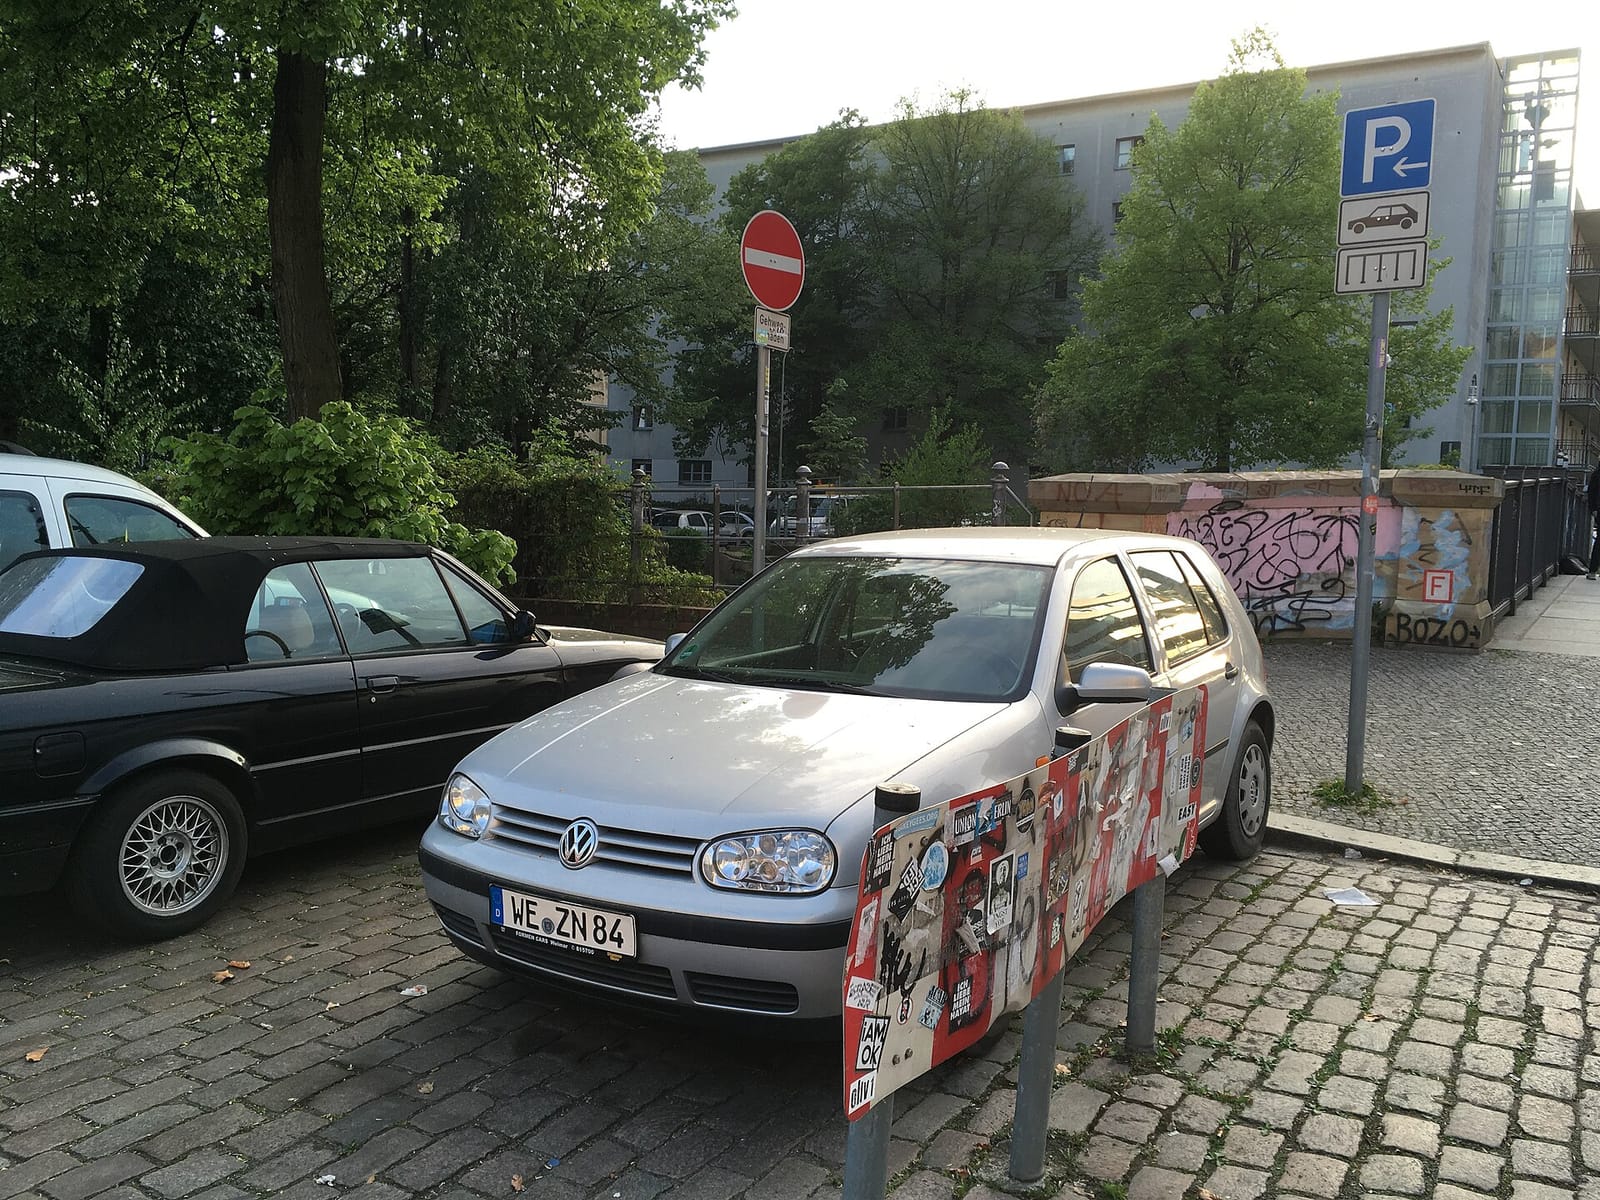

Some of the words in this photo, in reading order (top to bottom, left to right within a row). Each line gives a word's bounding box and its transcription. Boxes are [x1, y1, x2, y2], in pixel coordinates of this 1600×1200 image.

[1362, 116, 1412, 184] P
[1430, 576, 1446, 596] F
[1178, 803, 1196, 821] EASY
[955, 812, 977, 835] UNION
[511, 896, 539, 930] WE
[555, 906, 587, 941] ZN
[593, 914, 624, 949] 84
[957, 979, 969, 991] ICH
[952, 996, 970, 1011] MEIN
[953, 988, 971, 1003] LIEBE
[861, 1044, 881, 1066] OK
